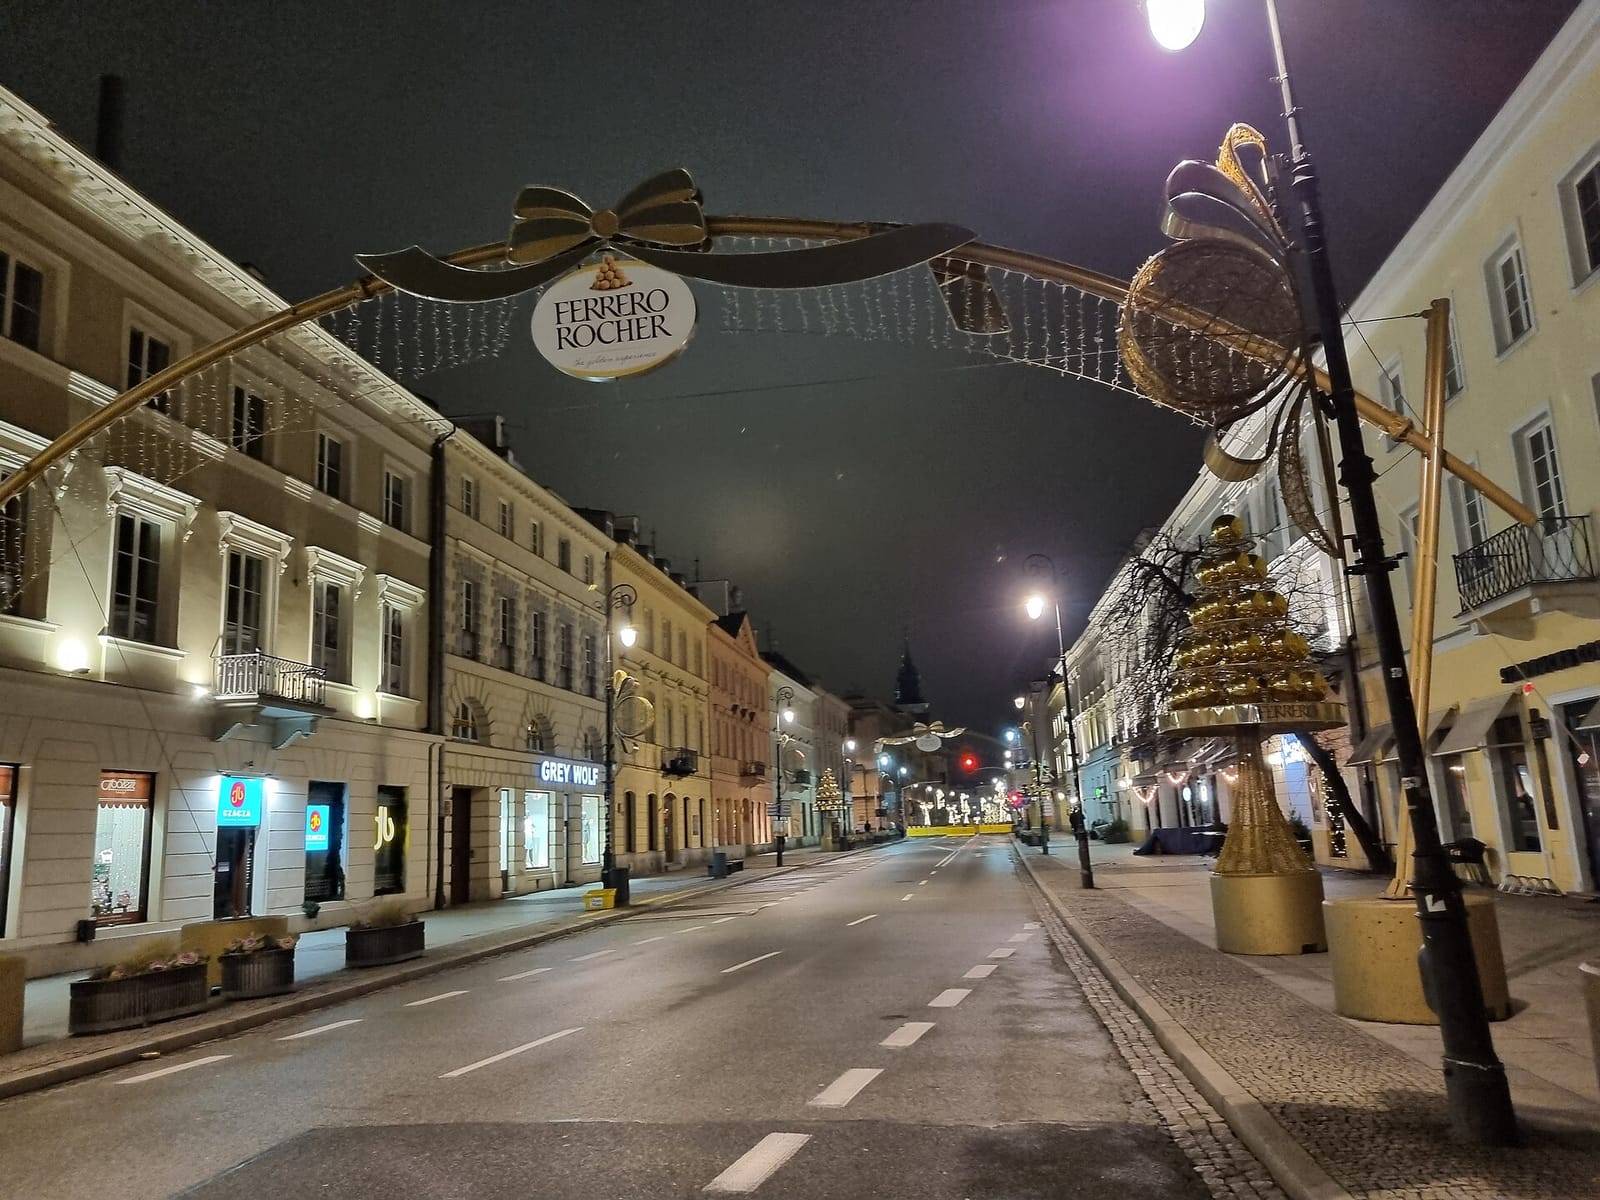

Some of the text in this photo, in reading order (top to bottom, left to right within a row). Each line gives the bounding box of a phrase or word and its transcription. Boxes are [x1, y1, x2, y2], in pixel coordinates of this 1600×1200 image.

[554, 289, 669, 325] FERRERO
[556, 315, 672, 350] ROCHER
[541, 761, 598, 786] GREY WOLF
